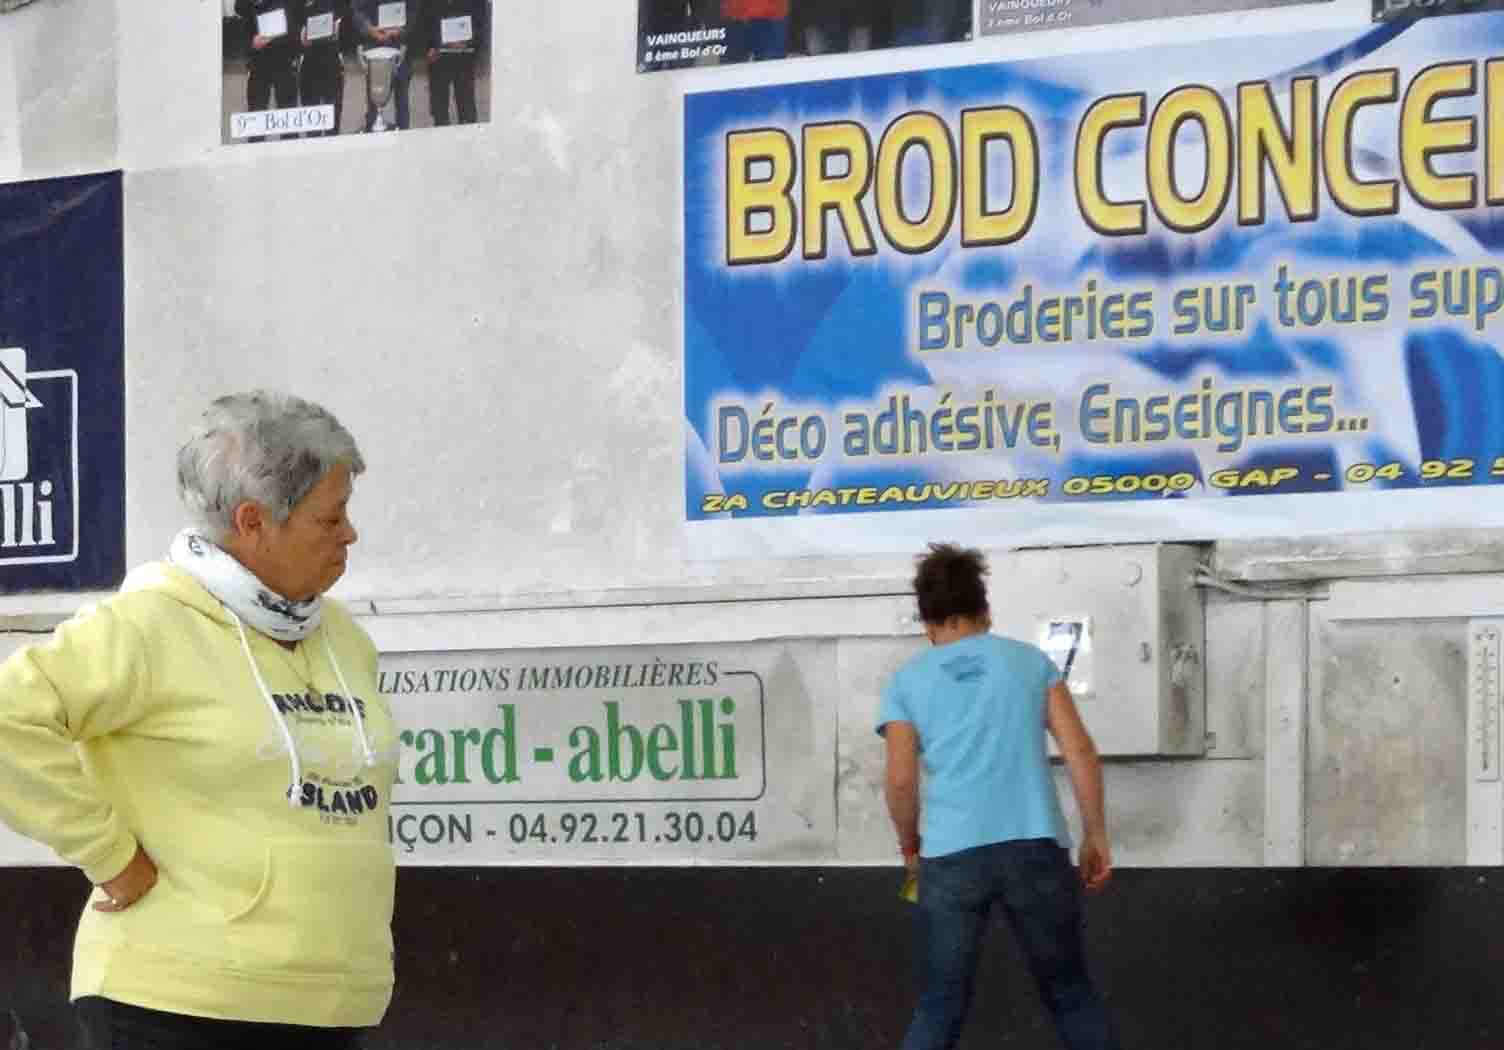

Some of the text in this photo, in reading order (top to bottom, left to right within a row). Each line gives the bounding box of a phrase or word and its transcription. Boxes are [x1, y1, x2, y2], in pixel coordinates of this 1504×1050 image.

[647, 27, 727, 46] VAINQUEURS
[680, 46, 700, 58] Bol
[265, 111, 289, 129] Bol
[725, 104, 1040, 266] BROD
[918, 280, 1154, 351] Broderies
[1173, 282, 1257, 335] sur
[1273, 264, 1389, 328] tous
[717, 378, 1369, 464] Déco adhésive, Enseignes...
[701, 494, 749, 513] ZA
[762, 478, 1051, 511] CHATEAUVIEUX
[1062, 472, 1196, 496] 05000
[1209, 465, 1300, 490] GAP
[1344, 460, 1404, 485] 04
[1418, 457, 1475, 480] 92
[378, 657, 720, 694] LISATIONS IMMOBILIÈRES
[567, 696, 739, 784] abelli
[287, 782, 378, 814] SLAND
[389, 814, 473, 853] ÇON
[509, 811, 759, 843] 04.92.21.30.04
